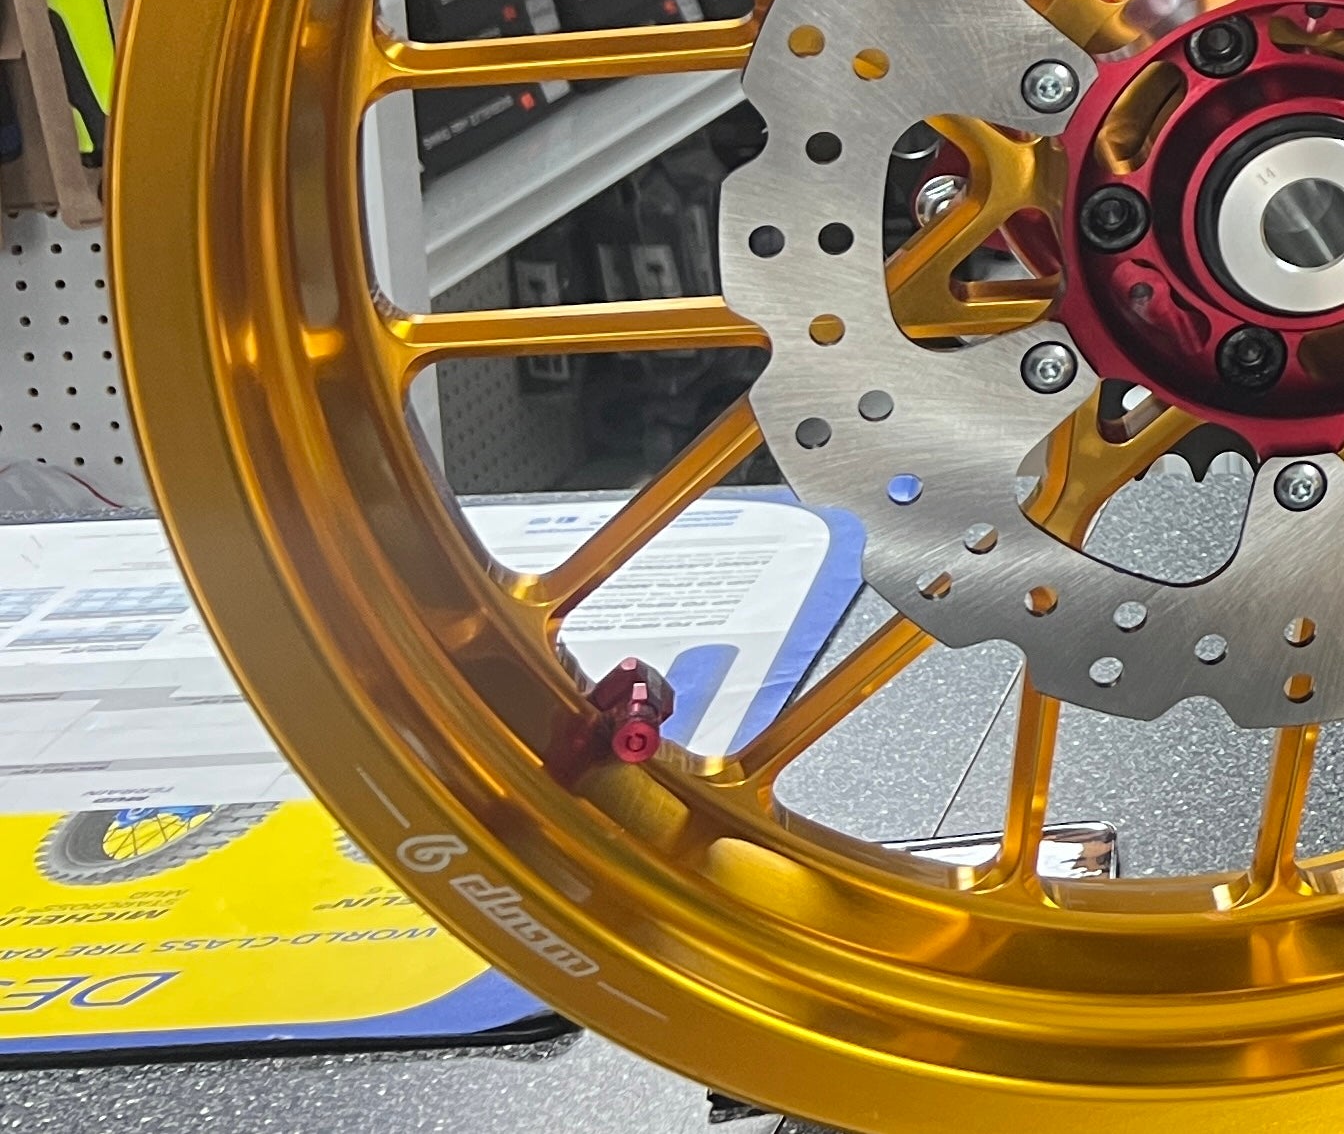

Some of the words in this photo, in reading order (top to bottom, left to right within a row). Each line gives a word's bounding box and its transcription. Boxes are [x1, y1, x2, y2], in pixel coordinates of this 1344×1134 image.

[395, 833, 469, 874] 9
[60, 941, 147, 957] TIRE
[160, 927, 437, 954] WORLD-CLASS
[0, 969, 179, 1011] DE
